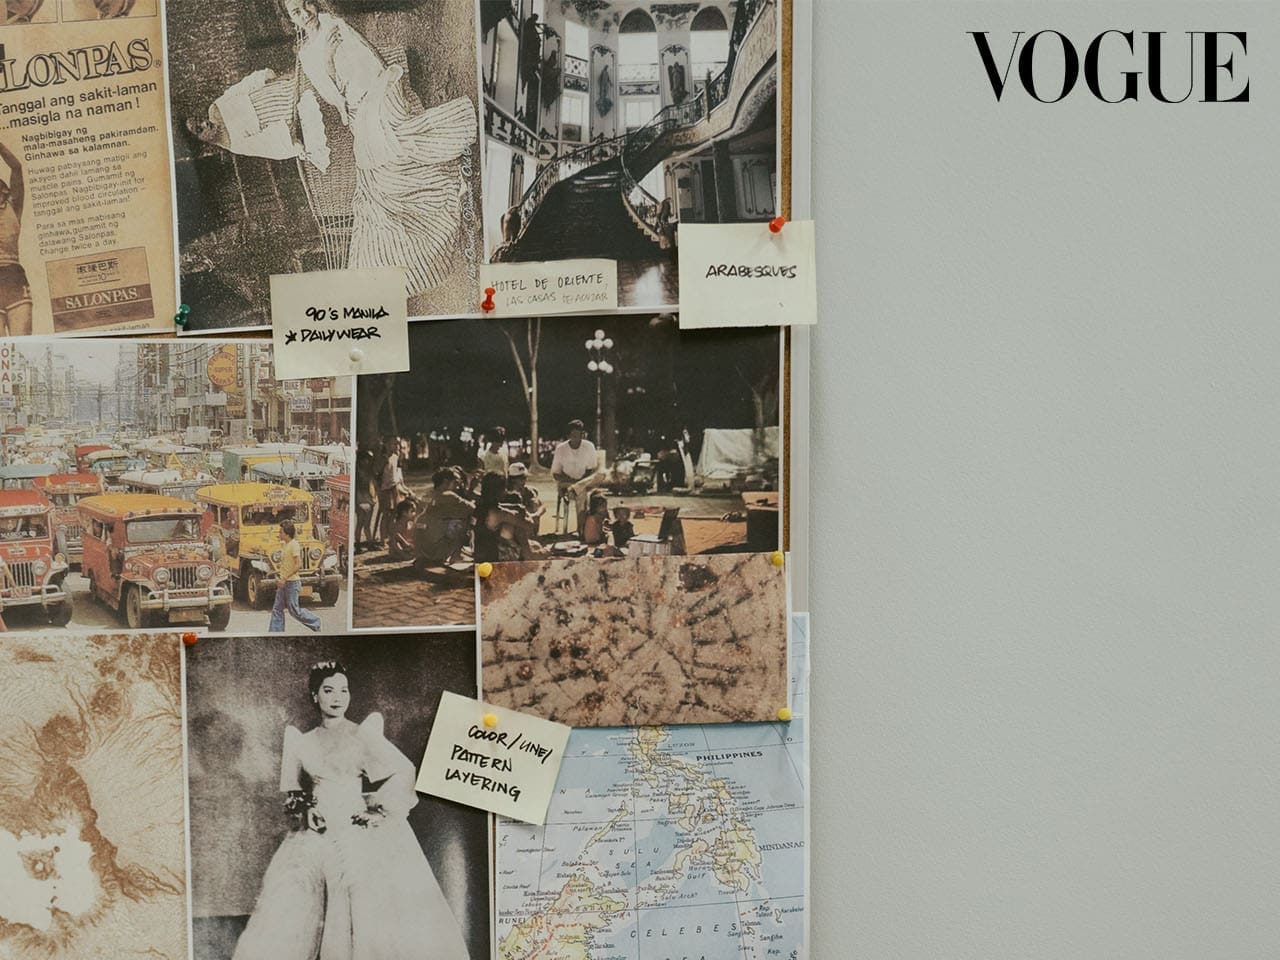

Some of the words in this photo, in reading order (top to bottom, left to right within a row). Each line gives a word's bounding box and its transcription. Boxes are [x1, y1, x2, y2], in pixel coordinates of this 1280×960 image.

[50, 93, 75, 107] ang
[79, 81, 158, 102] sakit-laman
[0, 114, 61, 131] ...masigla
[66, 106, 83, 120] na
[87, 98, 133, 117] naman
[22, 129, 73, 143] Nagbibigay
[76, 126, 88, 137] ng
[23, 135, 96, 152] mala-masaheng
[99, 125, 159, 141] pakiramdam.
[24, 149, 65, 162] Ginhawa
[68, 147, 79, 155] sa
[83, 140, 131, 153] kalamnan.
[706, 262, 799, 282] ARABESQUES
[491, 279, 527, 292] HOTEL
[534, 278, 549, 289] DE
[65, 287, 139, 310] SALONPAS
[305, 306, 339, 321] 90's
[343, 305, 390, 320] MANILA
[450, 743, 513, 773] PATTERN
[695, 751, 764, 762] PHILIPPINES
[445, 768, 522, 803] LAYERING
[629, 922, 738, 938] CELEBES
